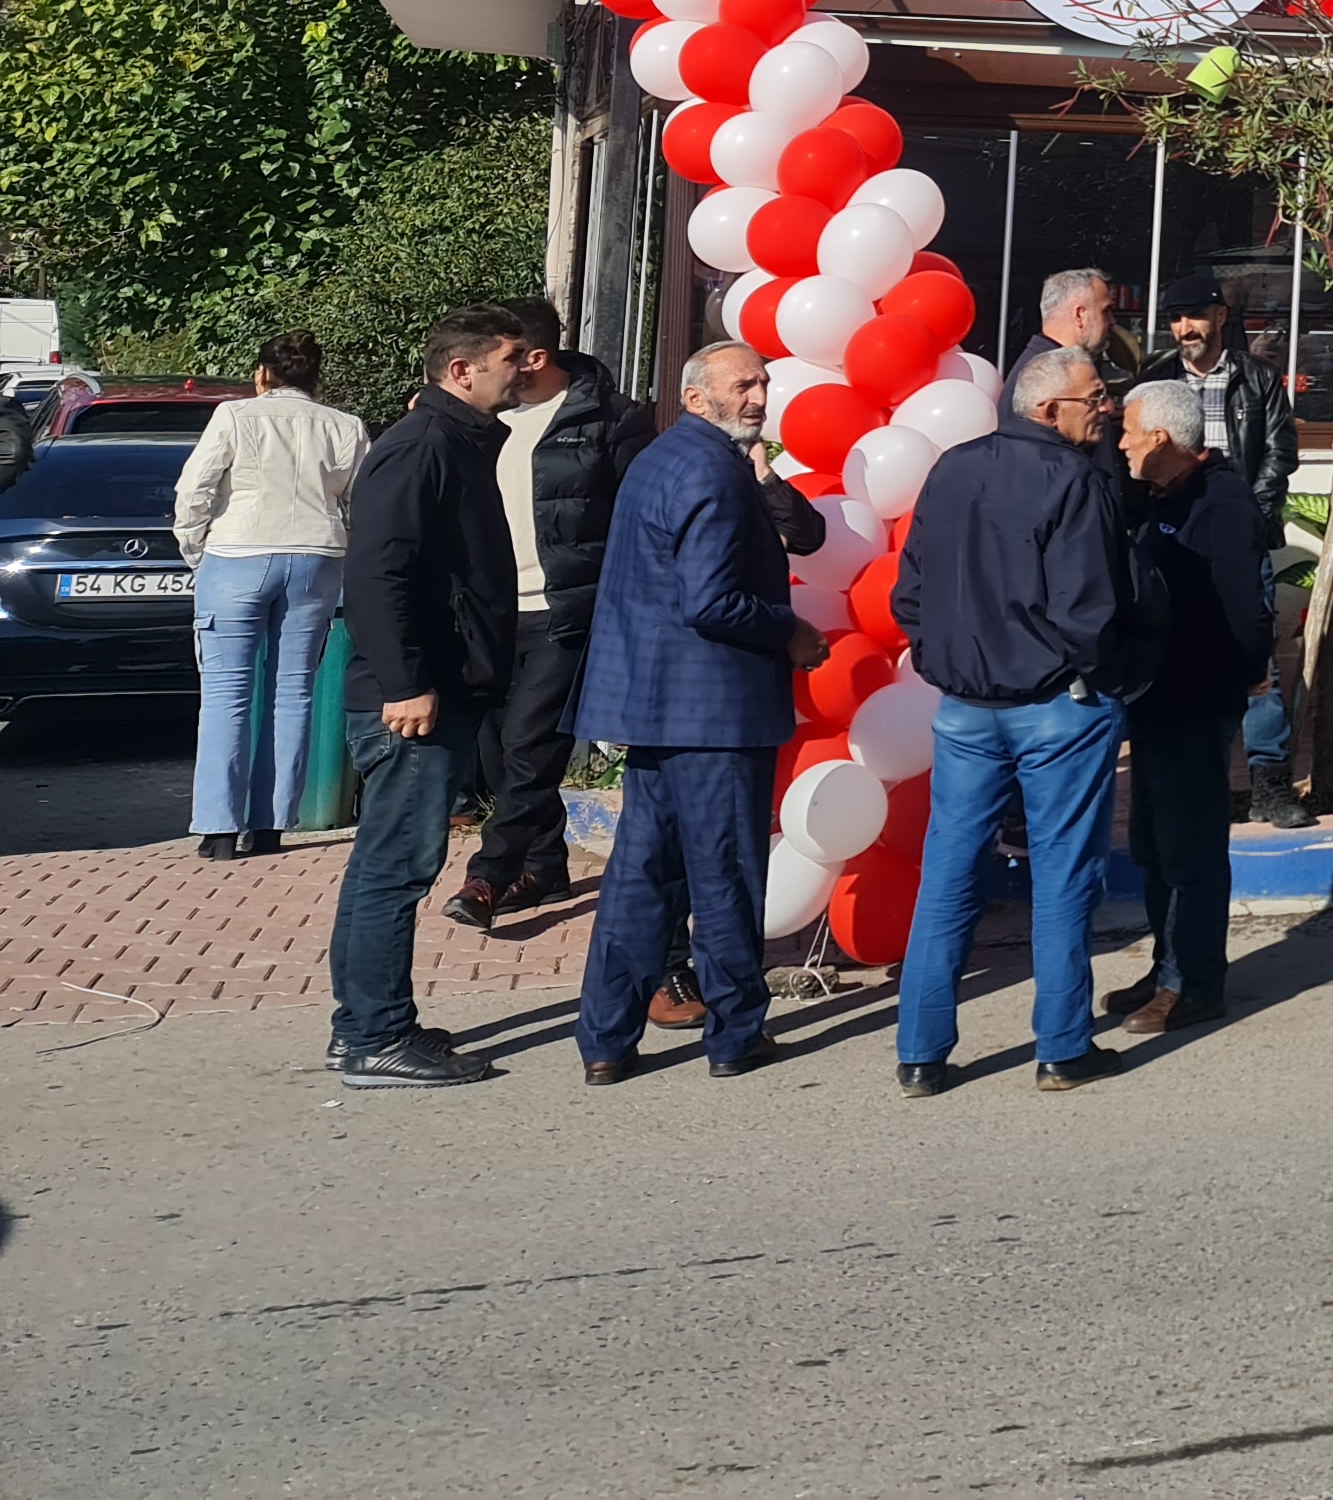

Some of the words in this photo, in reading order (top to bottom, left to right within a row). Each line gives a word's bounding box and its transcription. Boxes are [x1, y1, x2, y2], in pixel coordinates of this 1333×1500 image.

[74, 574, 102, 594] 54
[112, 574, 146, 594] KG
[156, 573, 195, 594] 454
